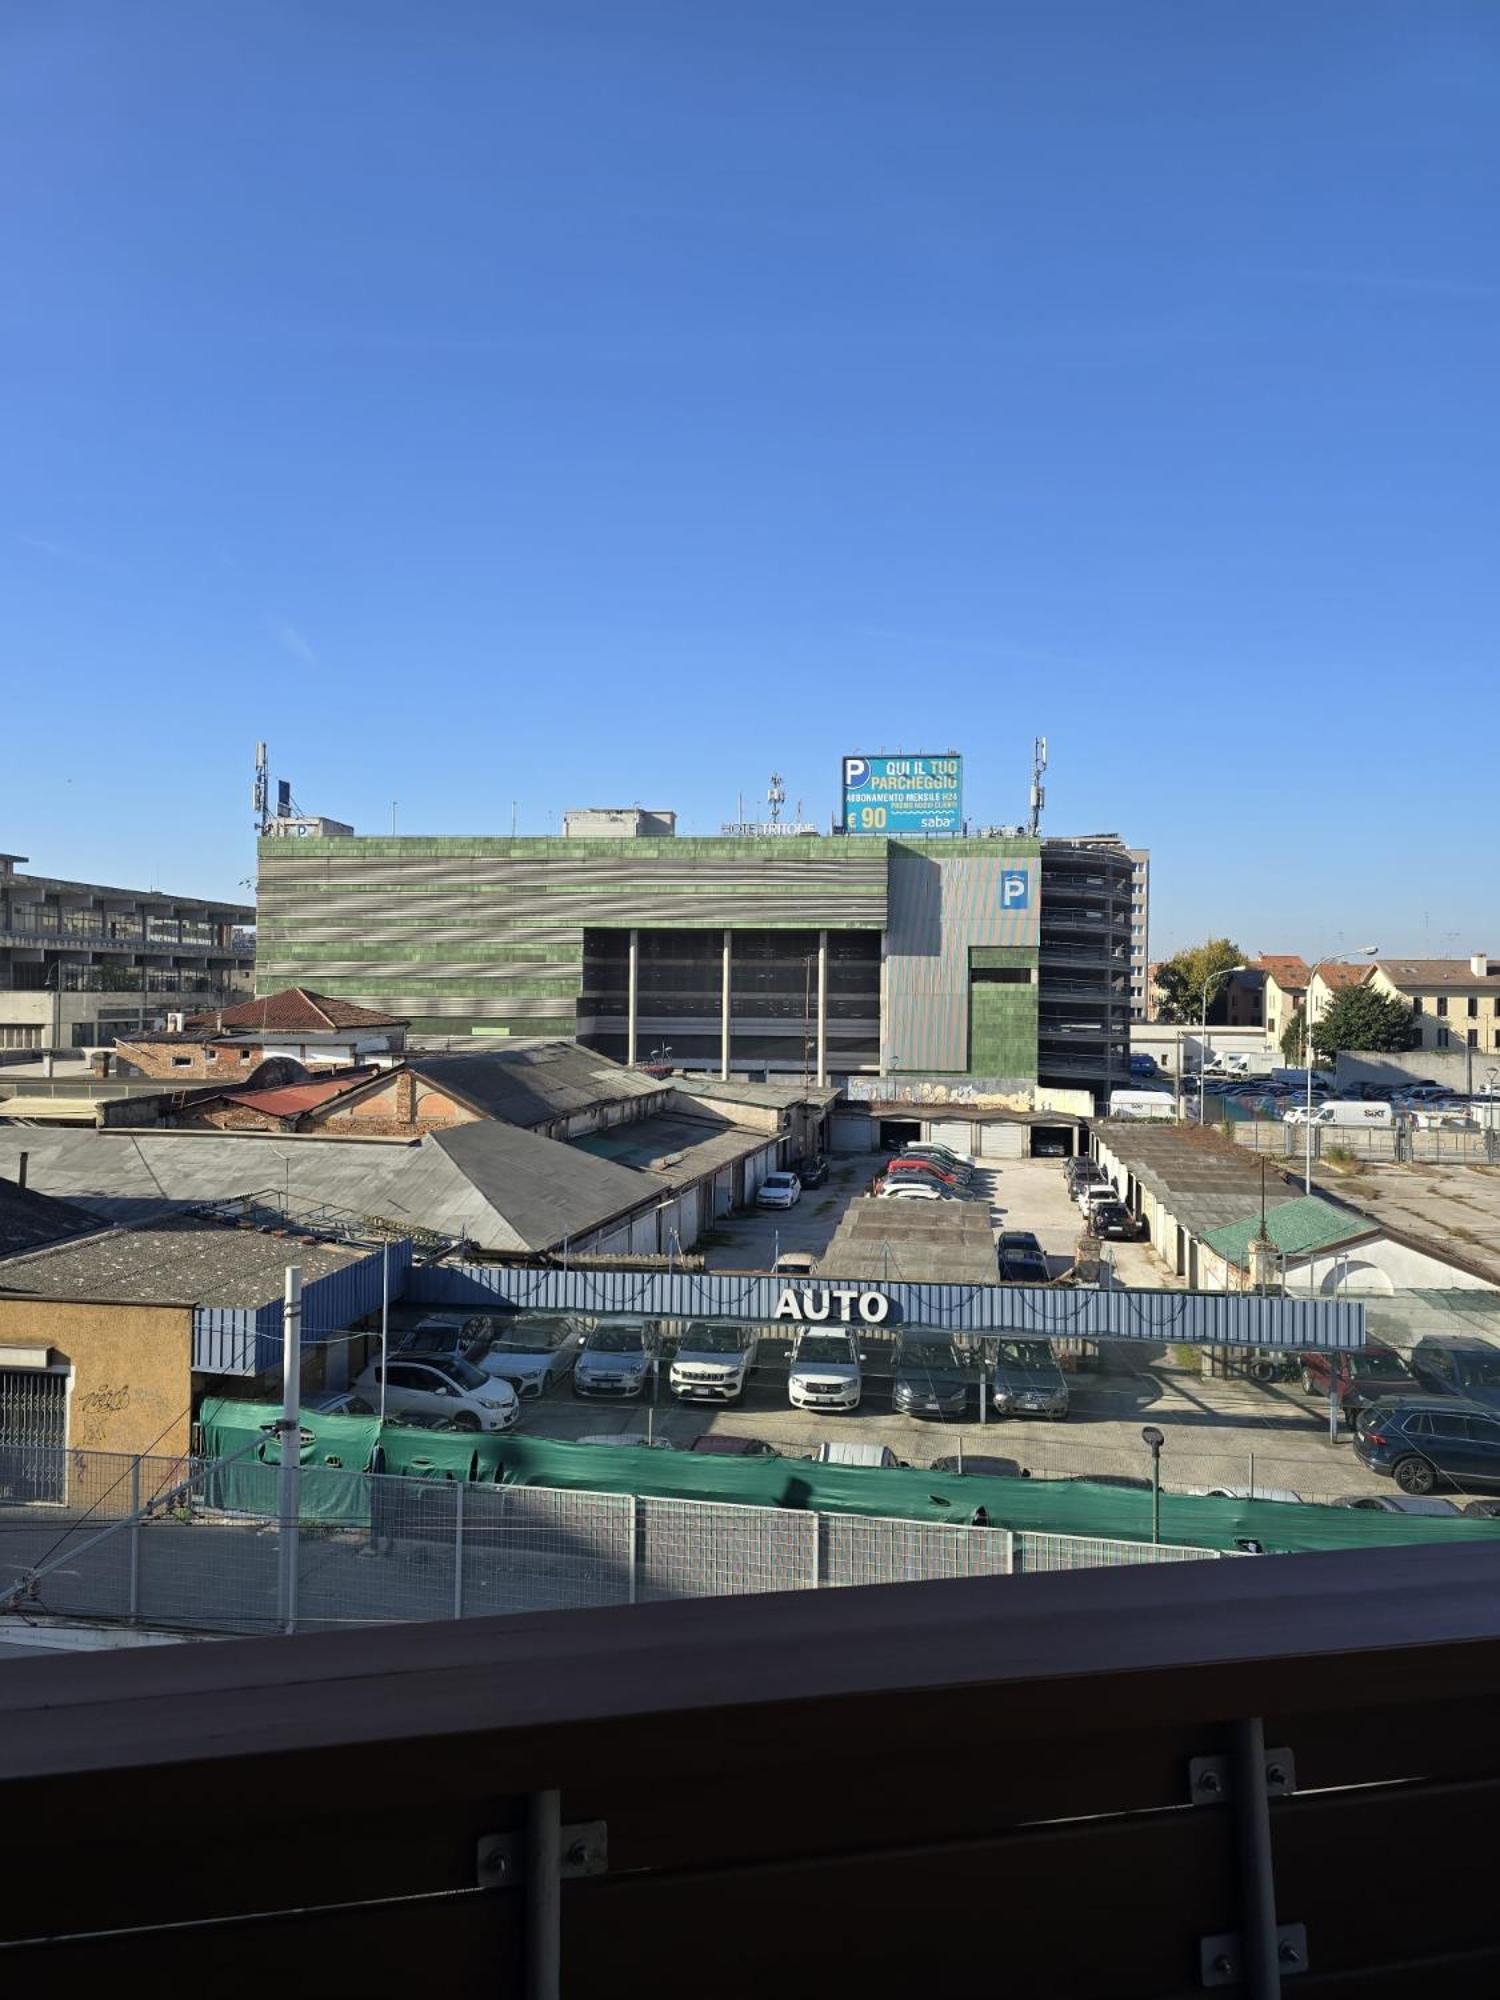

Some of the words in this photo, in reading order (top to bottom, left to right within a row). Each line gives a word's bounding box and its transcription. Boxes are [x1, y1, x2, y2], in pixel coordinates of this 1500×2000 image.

[846, 760, 865, 784] P
[886, 761, 910, 775] QUI
[914, 761, 926, 775] IL
[930, 760, 957, 774] TUO
[871, 776, 957, 789] PARCHEGGIO
[846, 793, 904, 802] ABBONAMENTO
[906, 793, 939, 802] MENSILE
[861, 807, 886, 828] 90
[921, 816, 950, 828] saba
[1004, 880, 1025, 906] P
[773, 1288, 889, 1323] AUTO
